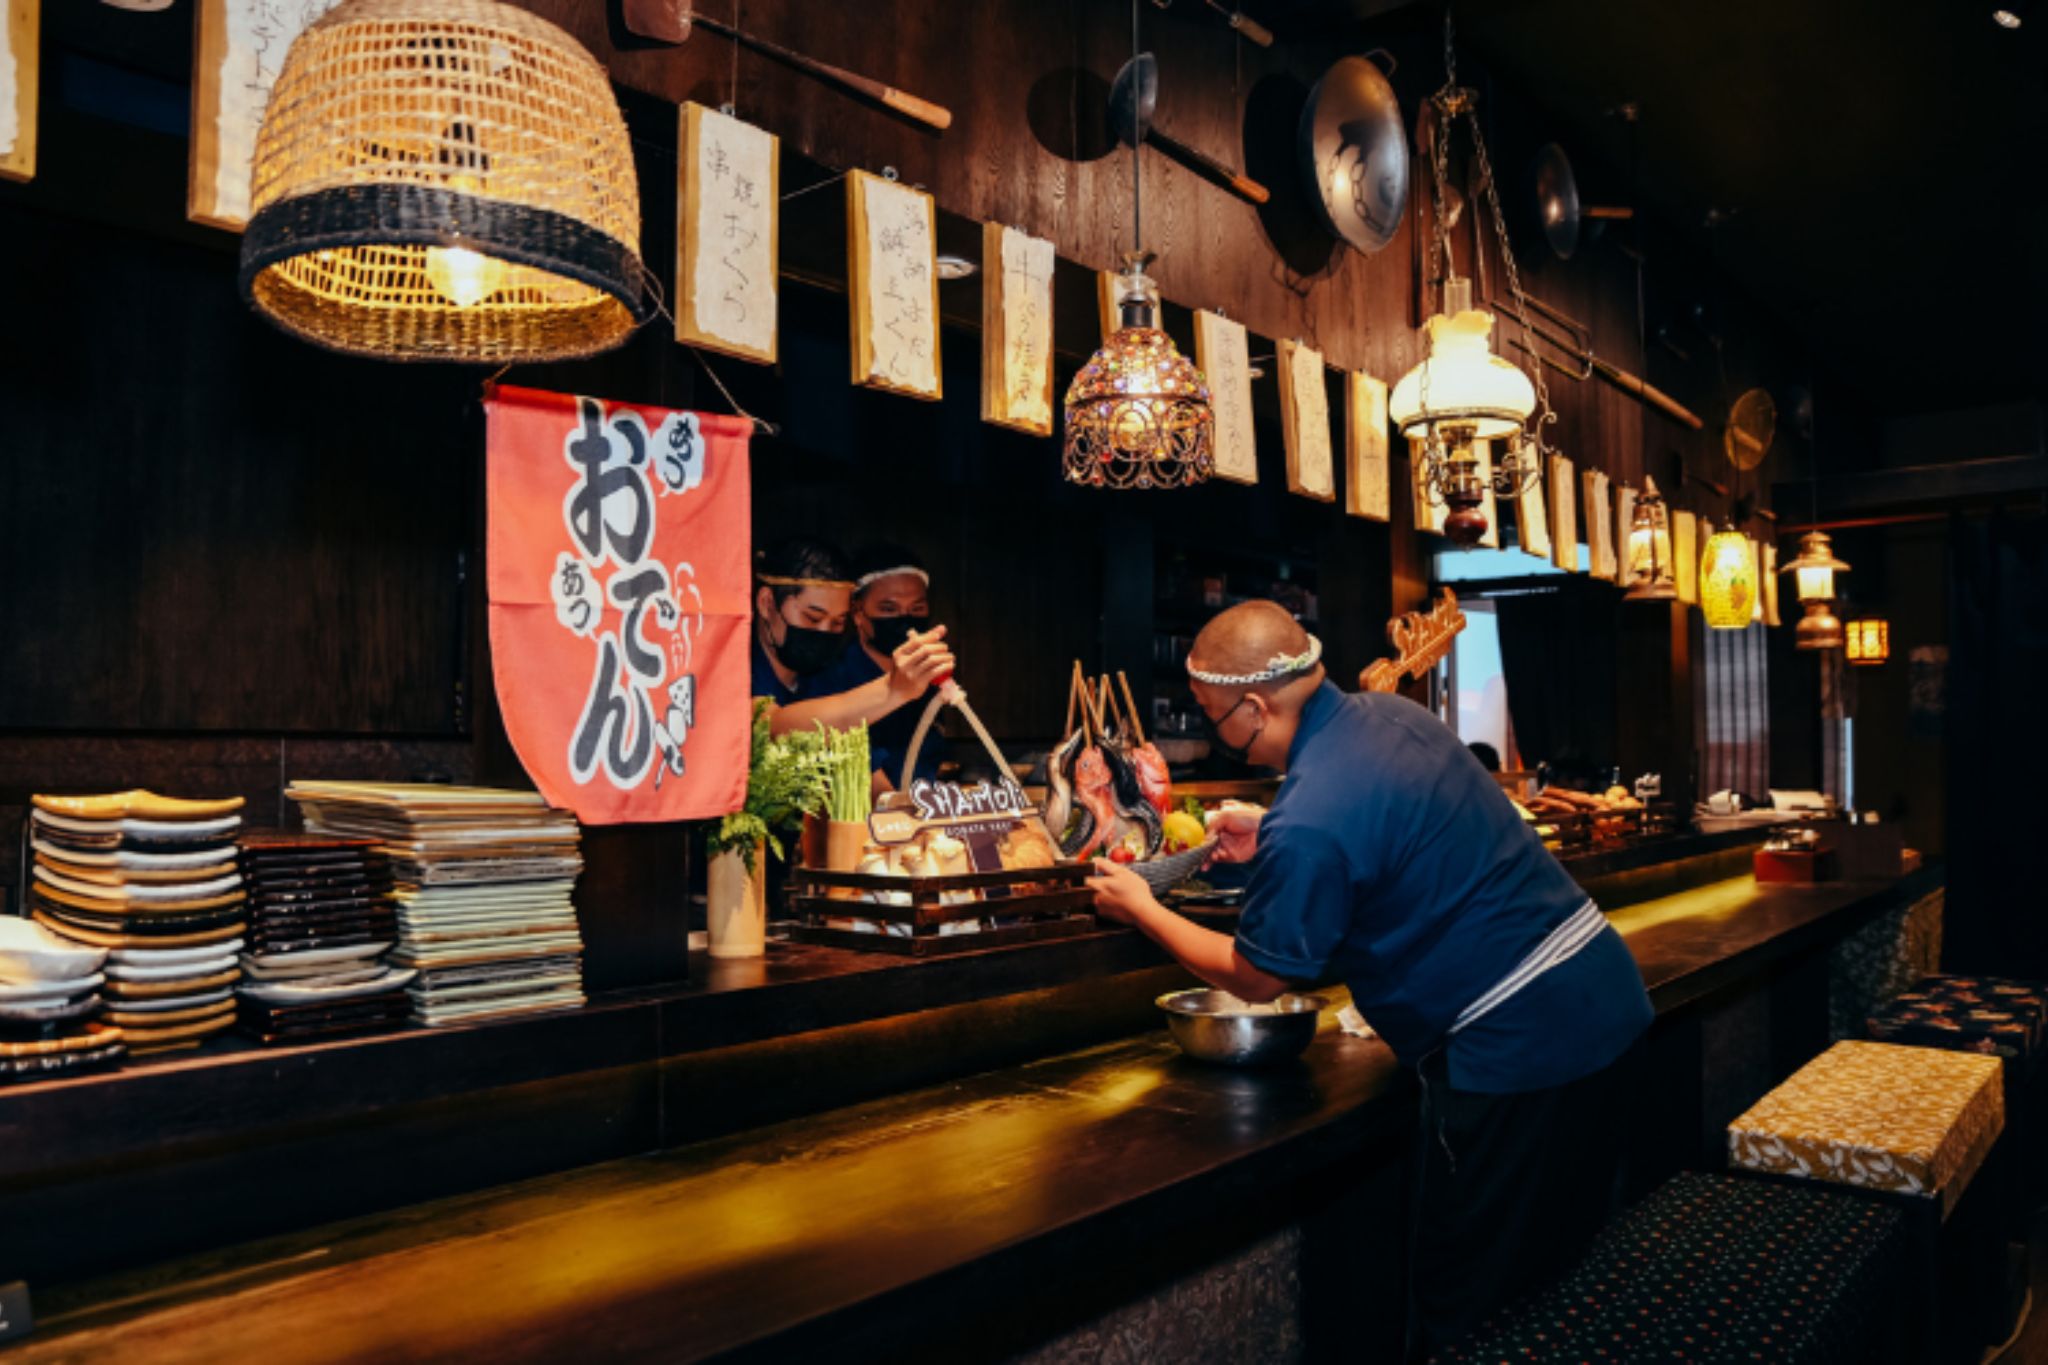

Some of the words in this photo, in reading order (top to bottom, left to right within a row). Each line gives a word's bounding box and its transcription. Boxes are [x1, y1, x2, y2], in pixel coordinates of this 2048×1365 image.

[561, 560, 592, 630] あつ
[568, 396, 677, 783] おでん
